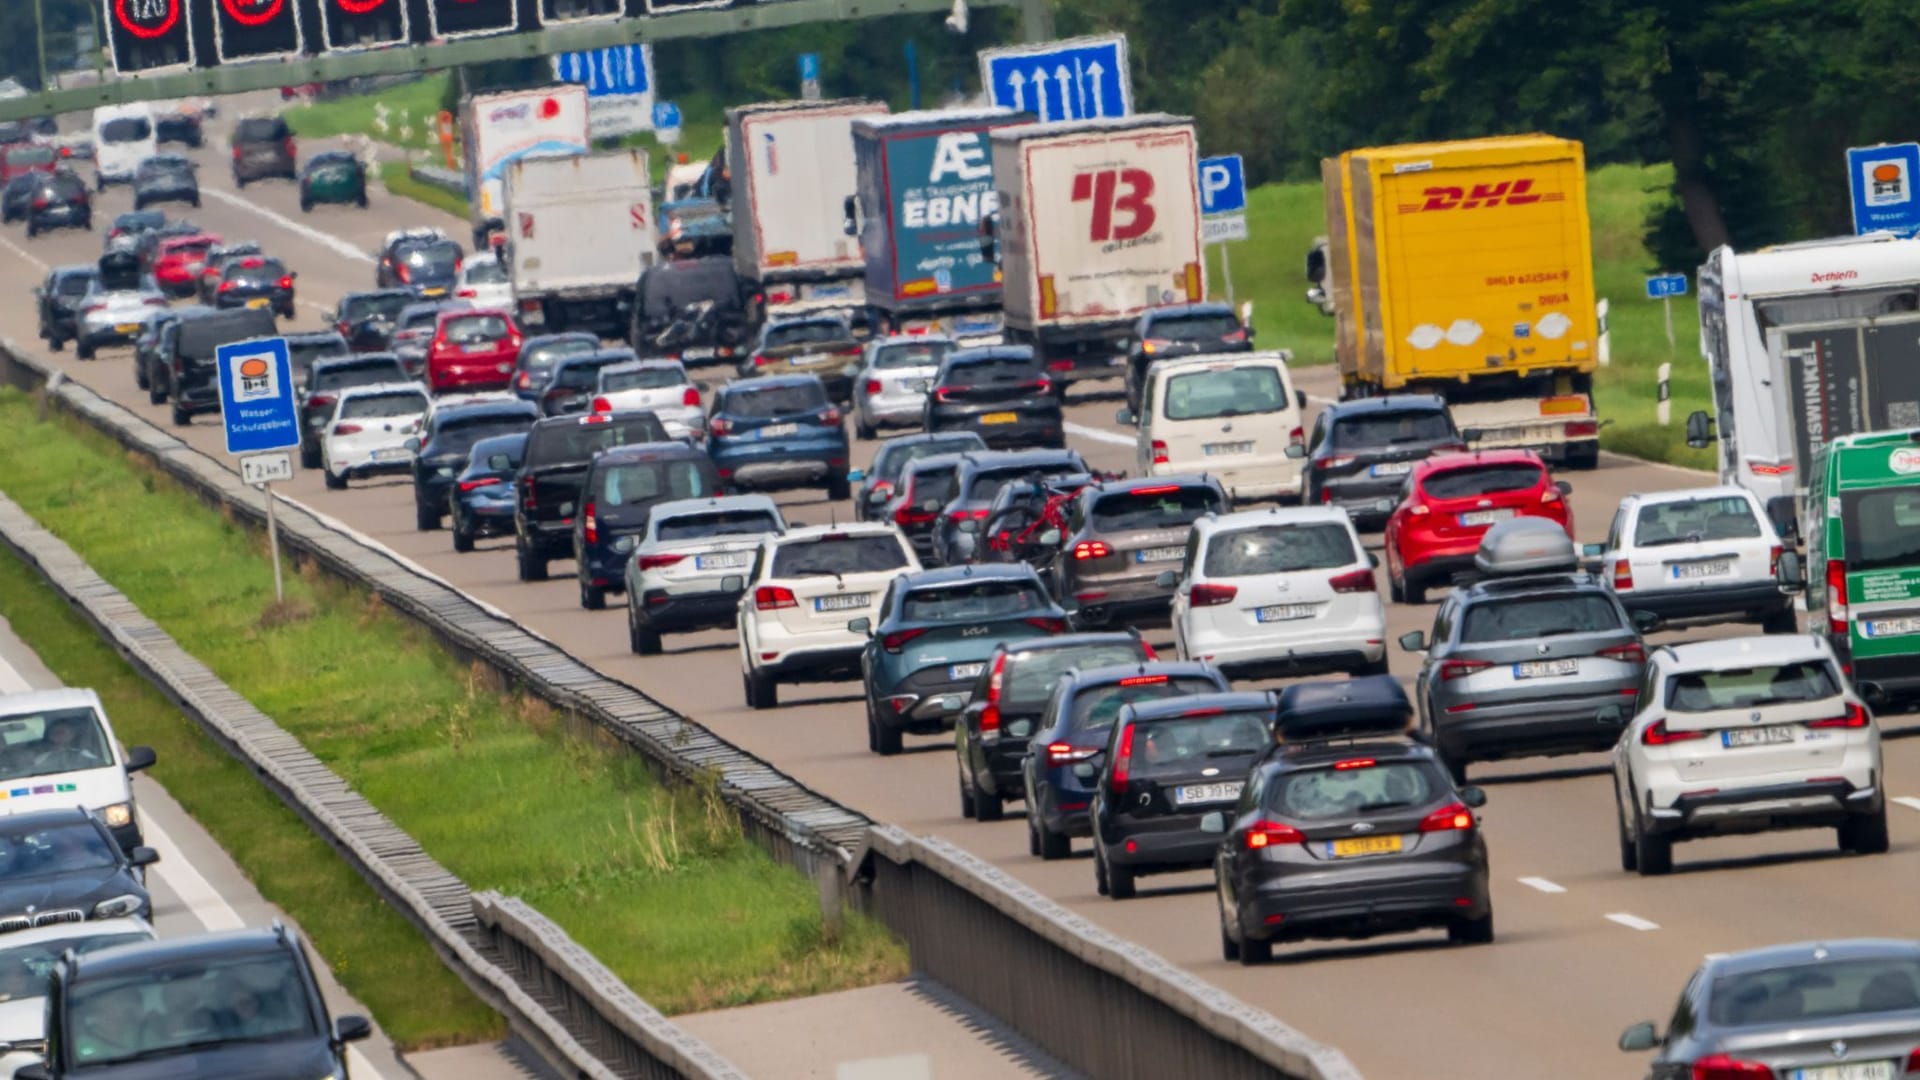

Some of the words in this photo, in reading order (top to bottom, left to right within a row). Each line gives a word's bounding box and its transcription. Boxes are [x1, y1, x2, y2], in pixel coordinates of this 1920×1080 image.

[1202, 164, 1230, 208] P
[1422, 179, 1543, 212] DHL
[256, 464, 263, 478] 2
[266, 463, 280, 475] km
